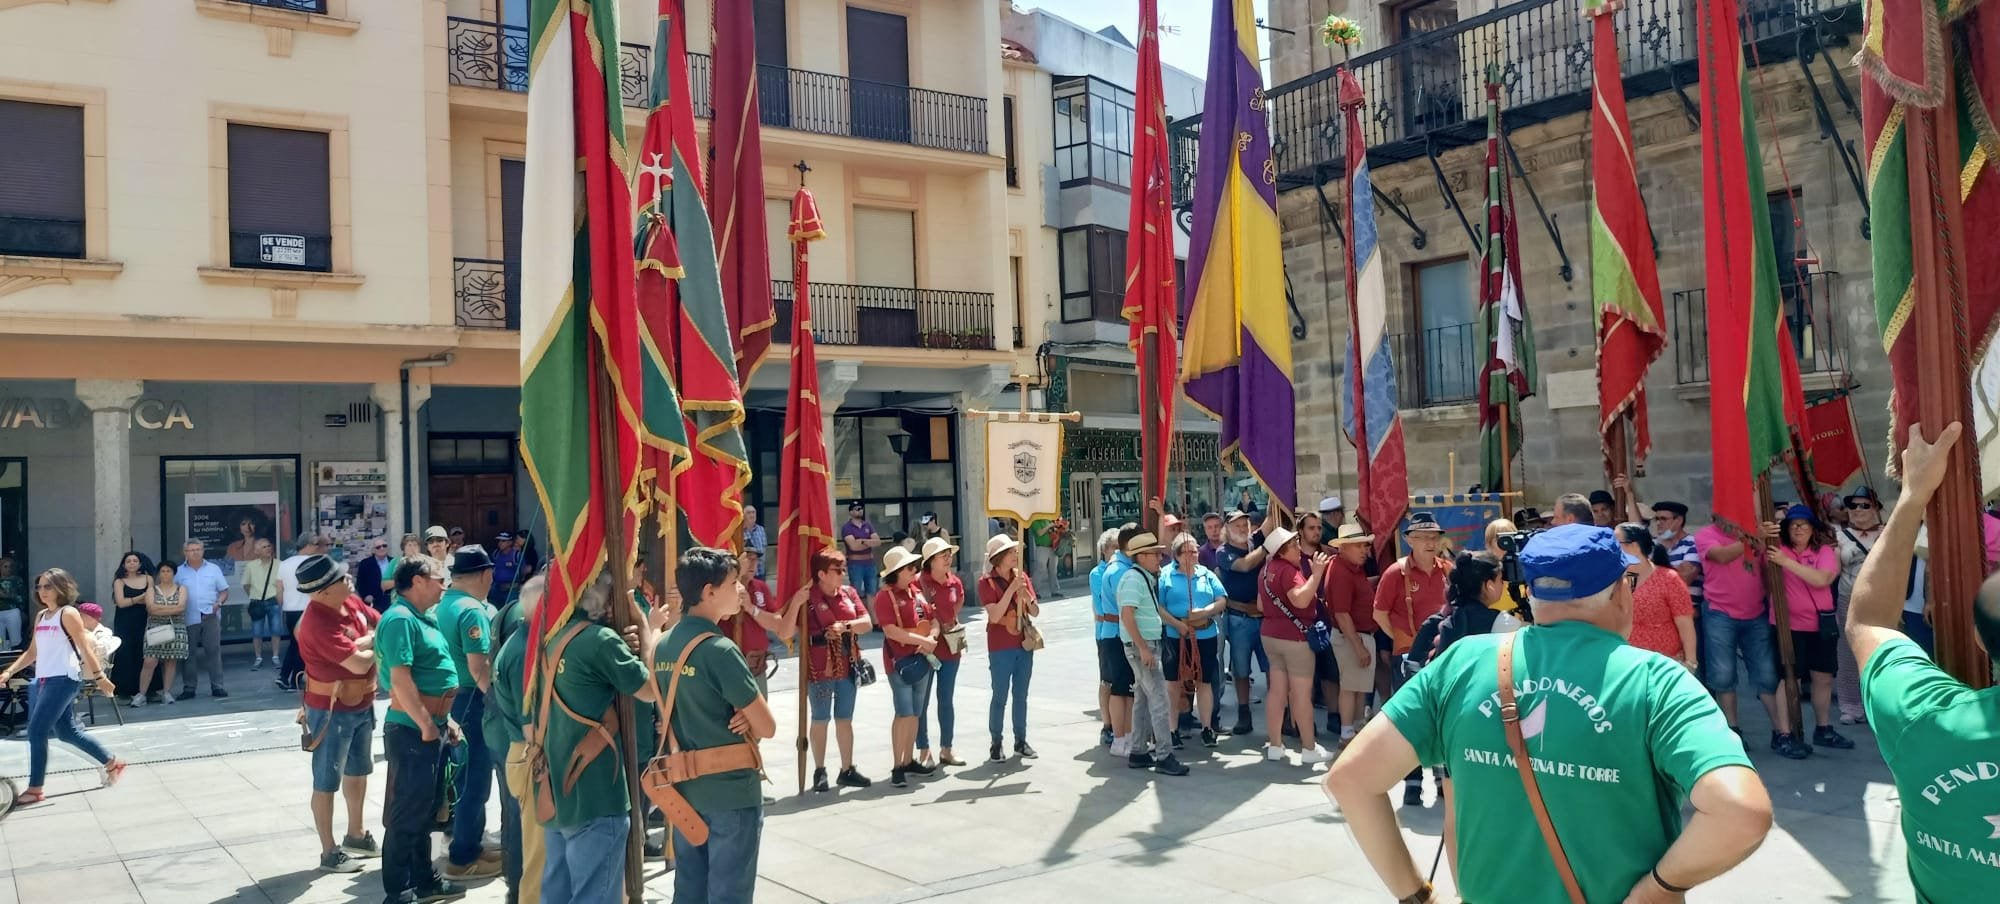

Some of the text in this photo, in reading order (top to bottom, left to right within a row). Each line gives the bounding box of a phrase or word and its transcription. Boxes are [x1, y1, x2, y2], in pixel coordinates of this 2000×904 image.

[262, 237, 304, 248] SE VENDE
[1464, 747, 1500, 767] SANTA
[1557, 762, 1575, 778] DE
[1577, 764, 1620, 784] TORRE
[1916, 830, 1963, 860] SANTA
